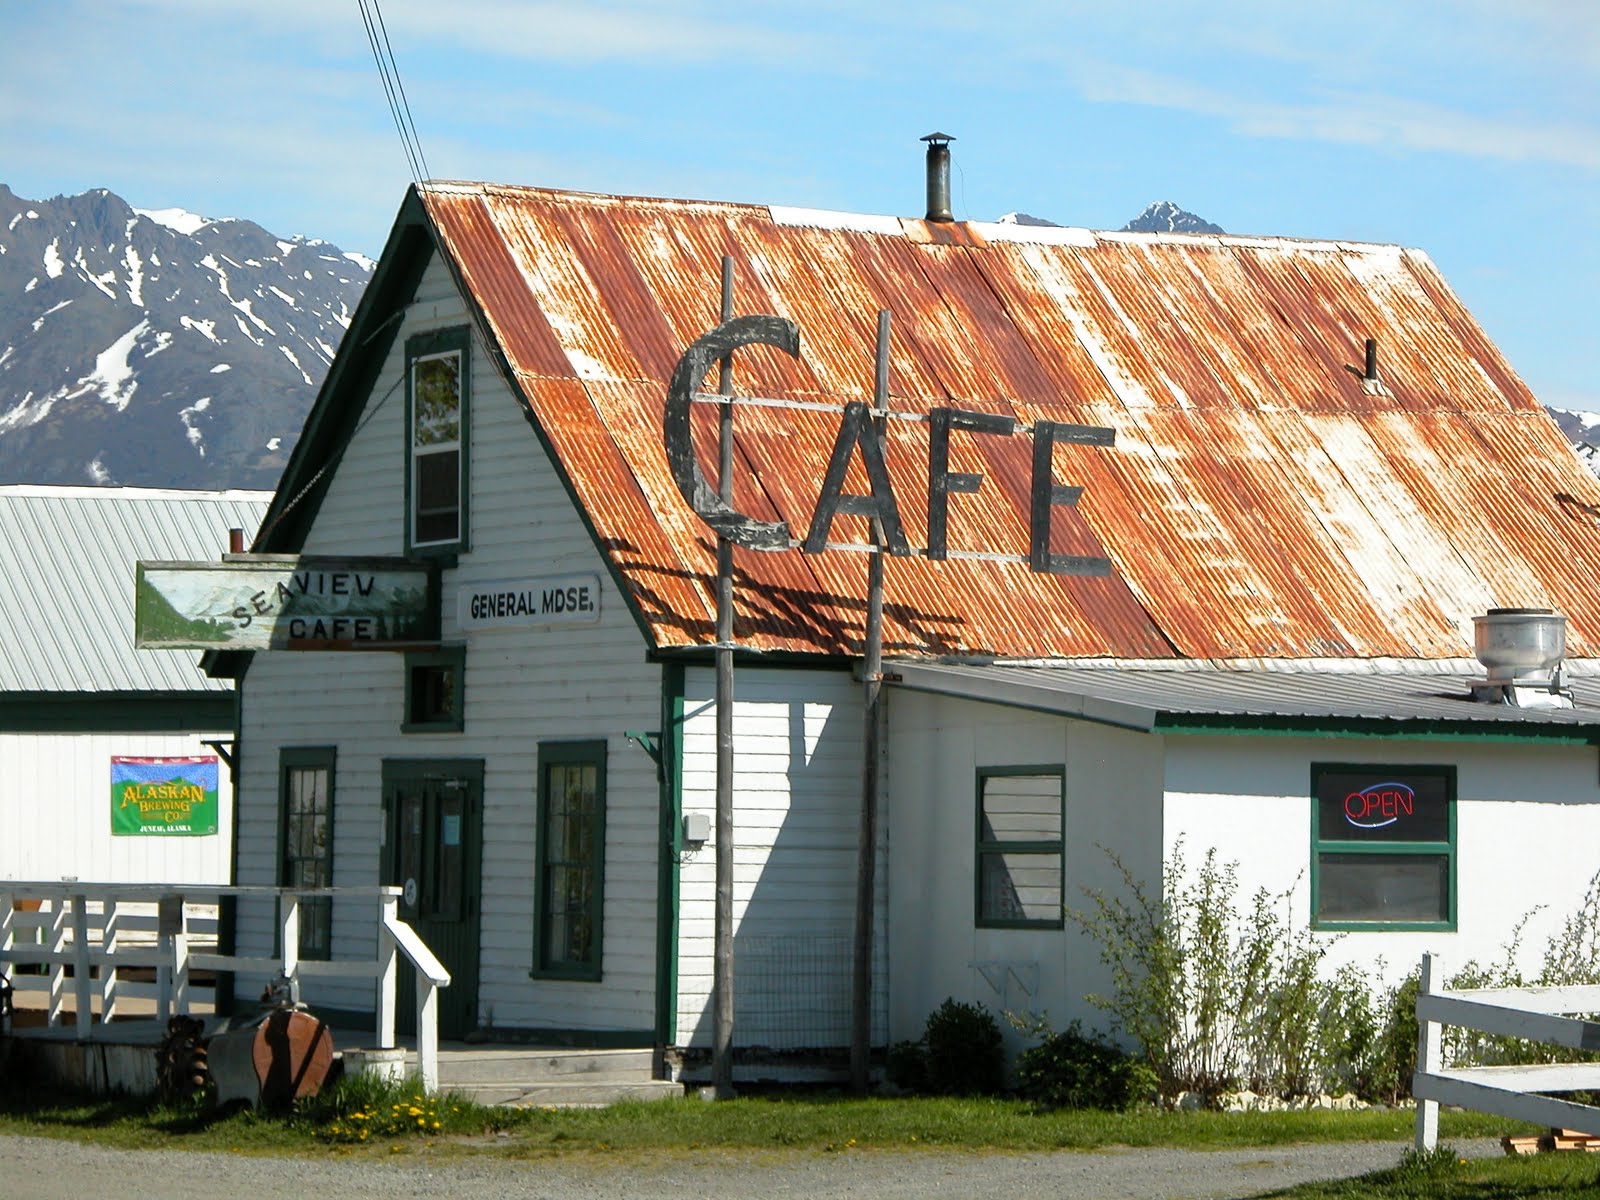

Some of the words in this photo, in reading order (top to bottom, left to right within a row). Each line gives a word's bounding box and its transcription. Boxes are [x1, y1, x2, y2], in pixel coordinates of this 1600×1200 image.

[664, 314, 1116, 577] CAFE
[232, 571, 375, 628] SEAVIEW
[471, 591, 536, 619] GENERAL
[541, 586, 594, 614] MDSE.
[289, 618, 372, 641] CAFE
[121, 785, 205, 808] ALASKAN
[139, 801, 191, 812] BREWING
[1344, 791, 1414, 818] OPEN
